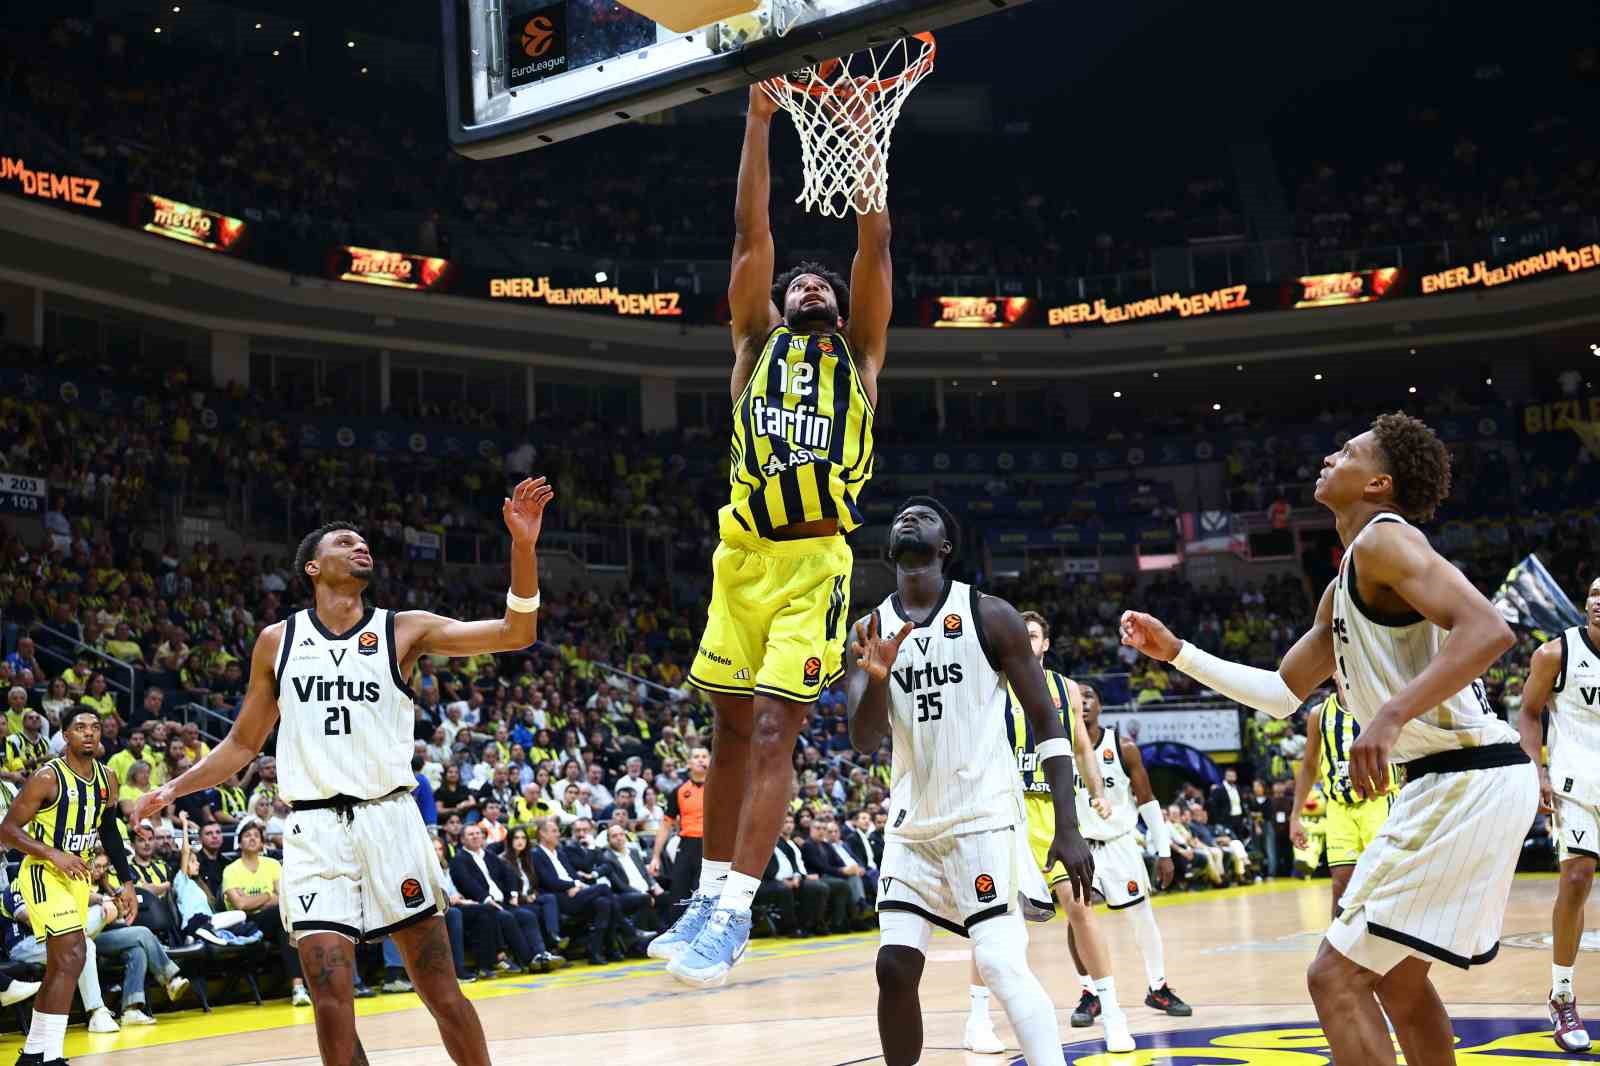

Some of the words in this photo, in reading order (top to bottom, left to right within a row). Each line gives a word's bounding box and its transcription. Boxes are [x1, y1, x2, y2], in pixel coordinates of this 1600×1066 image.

[511, 56, 566, 77] EuroLeague
[23, 171, 102, 207] DEMEZ
[153, 207, 211, 231] metro
[351, 257, 412, 274] metro
[616, 292, 682, 315] DEMEZ
[1178, 284, 1250, 316] DEMEZ
[777, 358, 814, 396] 12
[753, 397, 830, 449] tarfin
[707, 651, 732, 666] Hotels
[291, 675, 381, 703] Virtus
[892, 662, 963, 694] Vrtus
[324, 706, 352, 736] 21
[916, 692, 943, 722] 35
